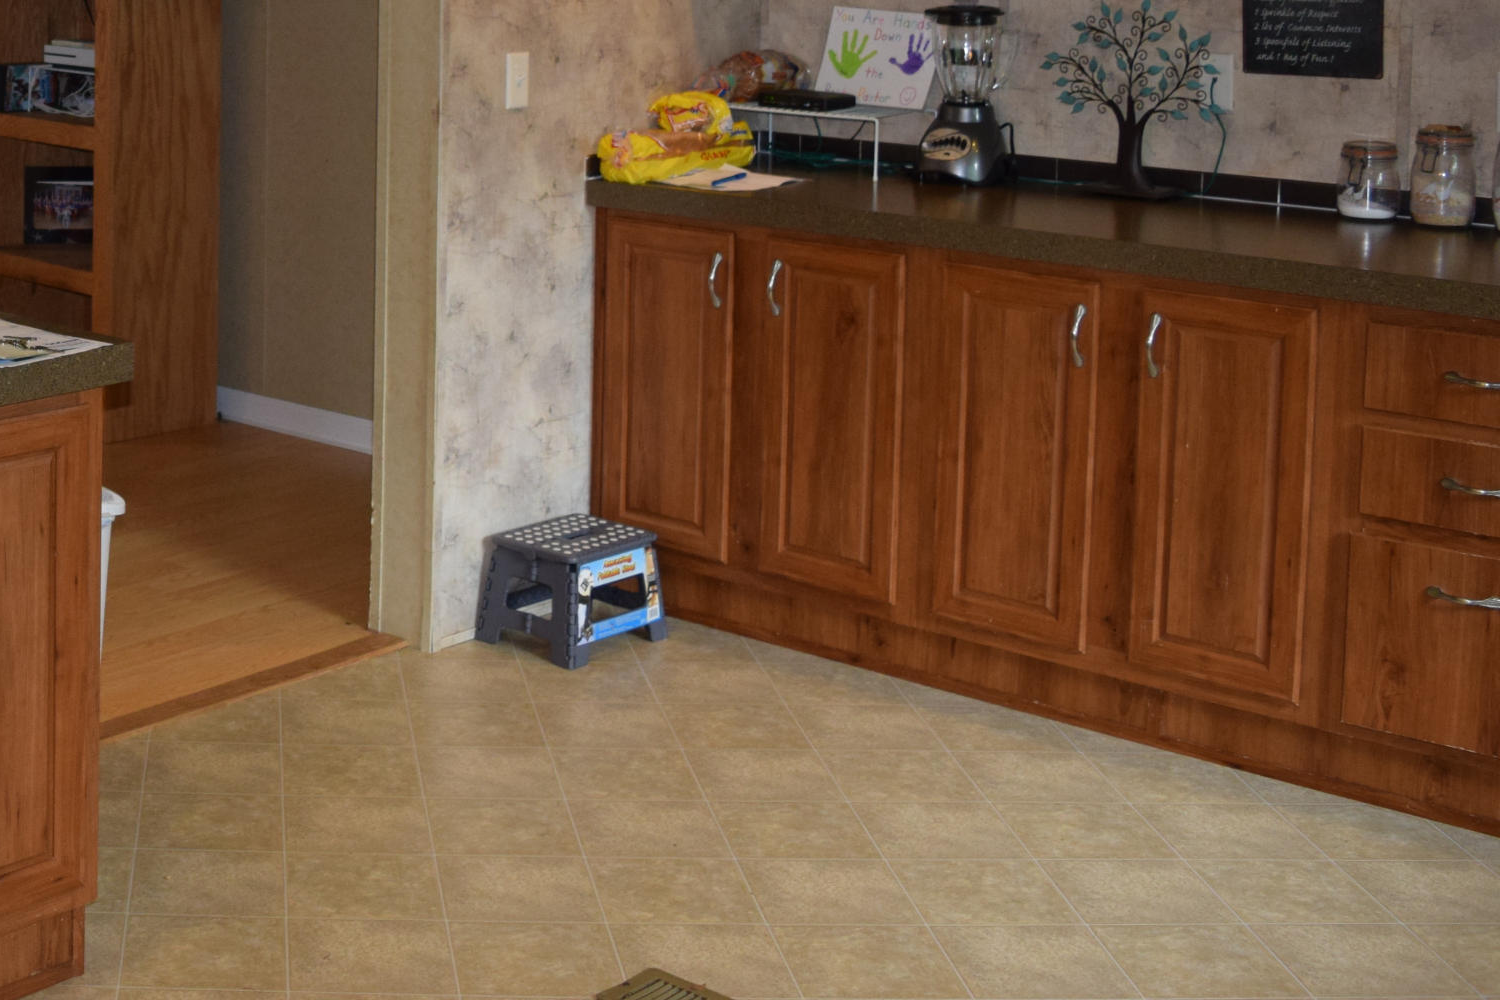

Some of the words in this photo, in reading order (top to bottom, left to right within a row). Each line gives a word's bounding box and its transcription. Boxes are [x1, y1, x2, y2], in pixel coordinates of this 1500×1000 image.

[836, 9, 855, 23] You
[863, 10, 886, 25] Are
[874, 27, 902, 41] Down
[865, 67, 884, 80] the
[857, 86, 892, 103] Pastor
